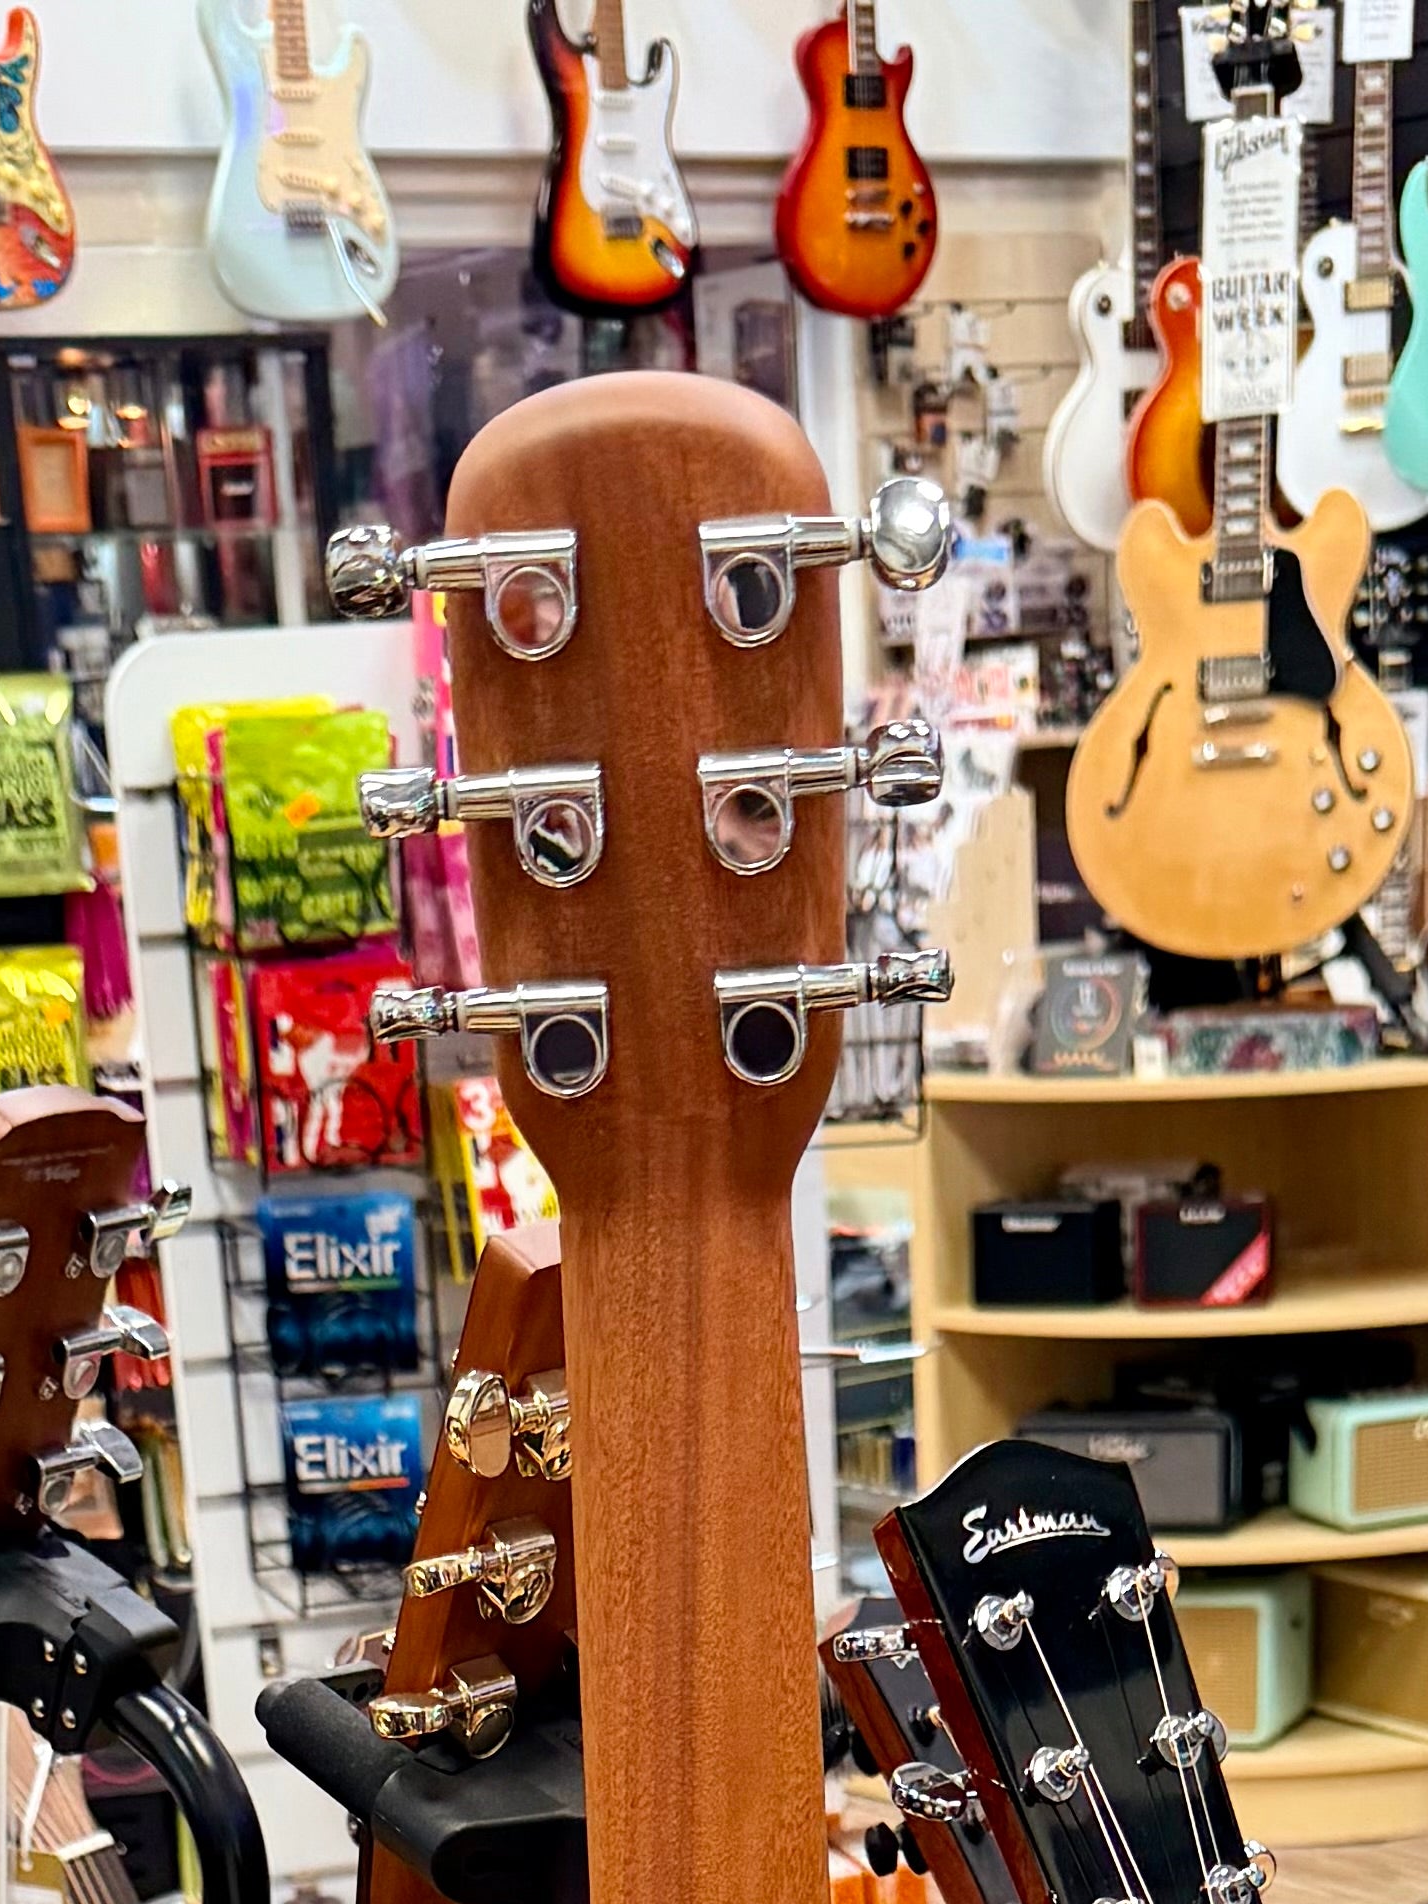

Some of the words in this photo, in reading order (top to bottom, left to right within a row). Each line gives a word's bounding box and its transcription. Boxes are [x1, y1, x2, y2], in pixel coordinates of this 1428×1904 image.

[283, 1229, 402, 1281] Elixir
[294, 1433, 409, 1482] Elixir
[962, 1504, 1112, 1564] Eastman
